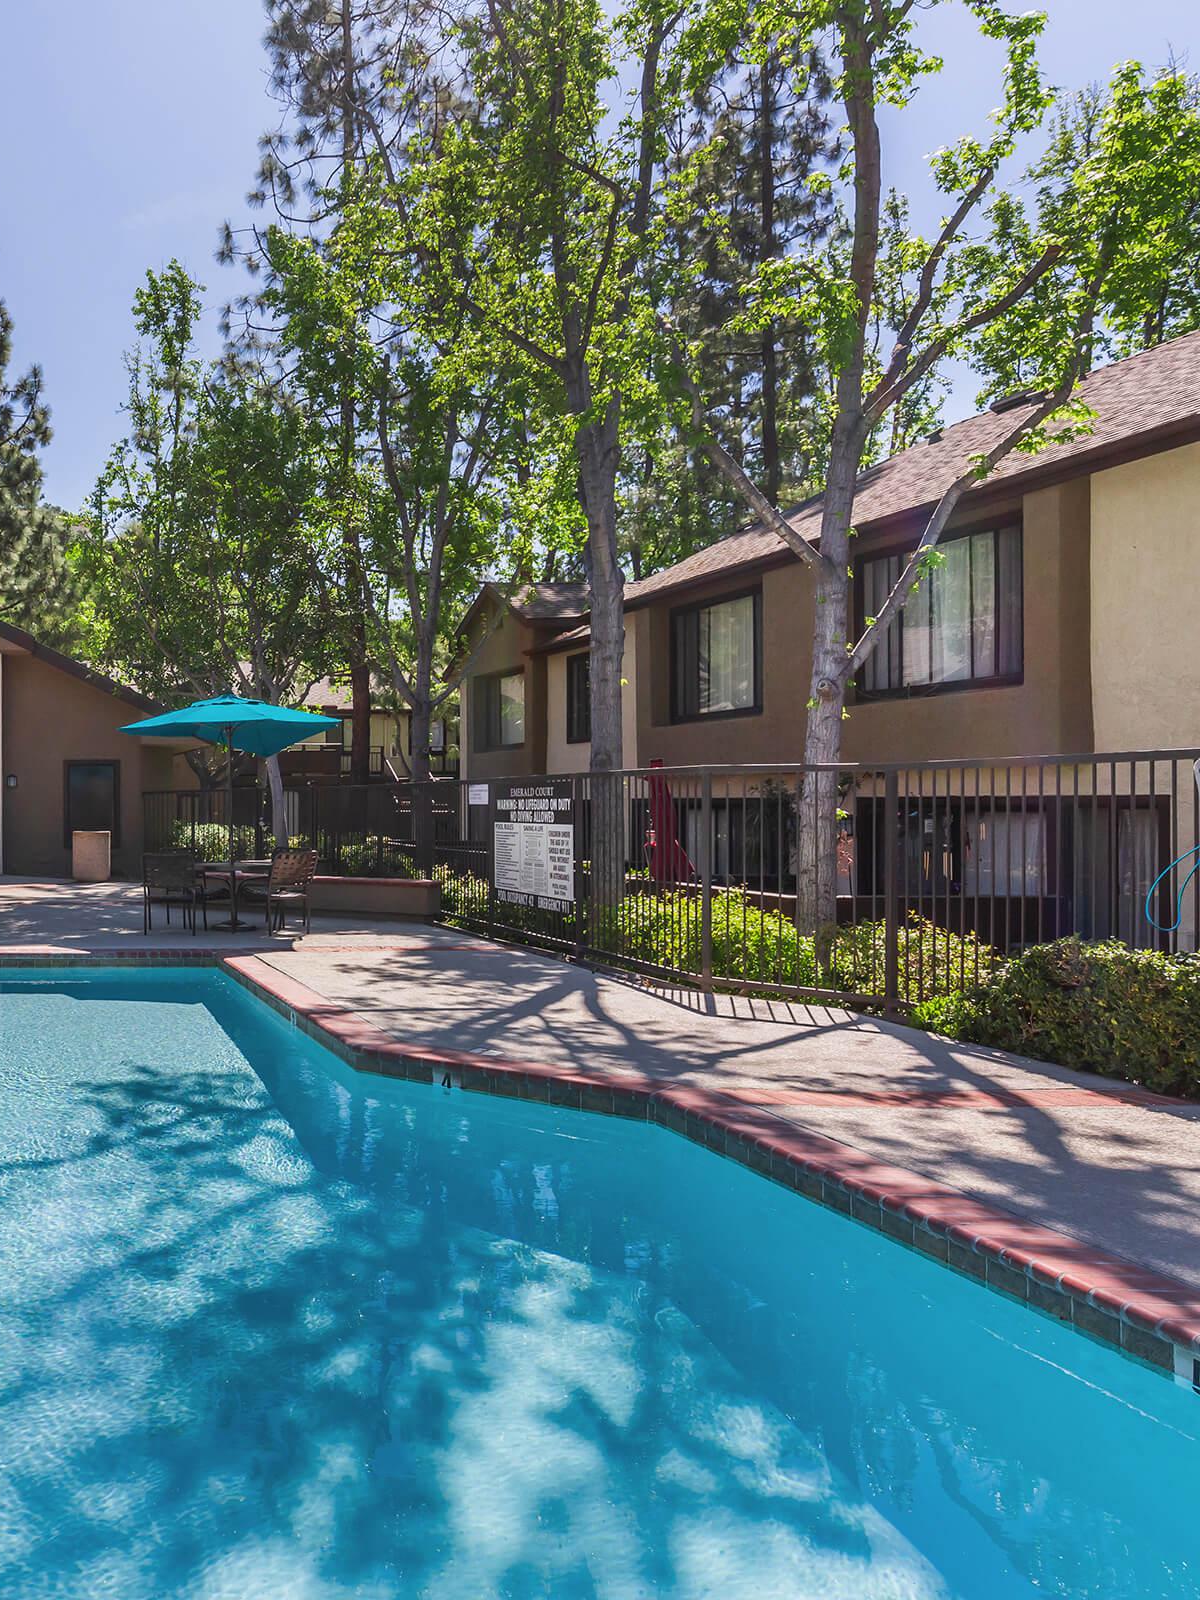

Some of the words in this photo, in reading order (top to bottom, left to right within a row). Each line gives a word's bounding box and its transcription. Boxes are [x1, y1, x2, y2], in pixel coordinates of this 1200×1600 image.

[510, 787, 534, 797] EMERALD
[535, 786, 554, 796] COURT
[518, 799, 525, 810] NO
[525, 799, 549, 810] LIFEGUARD
[550, 799, 558, 810] ON
[558, 799, 571, 810] DUTY
[510, 811, 517, 821] NO
[518, 811, 533, 822] DIVING
[533, 811, 555, 823] ALLOWED
[507, 891, 528, 905] OCCUPANCY
[537, 896, 561, 912] EMERGENCY
[561, 901, 570, 914] 911
